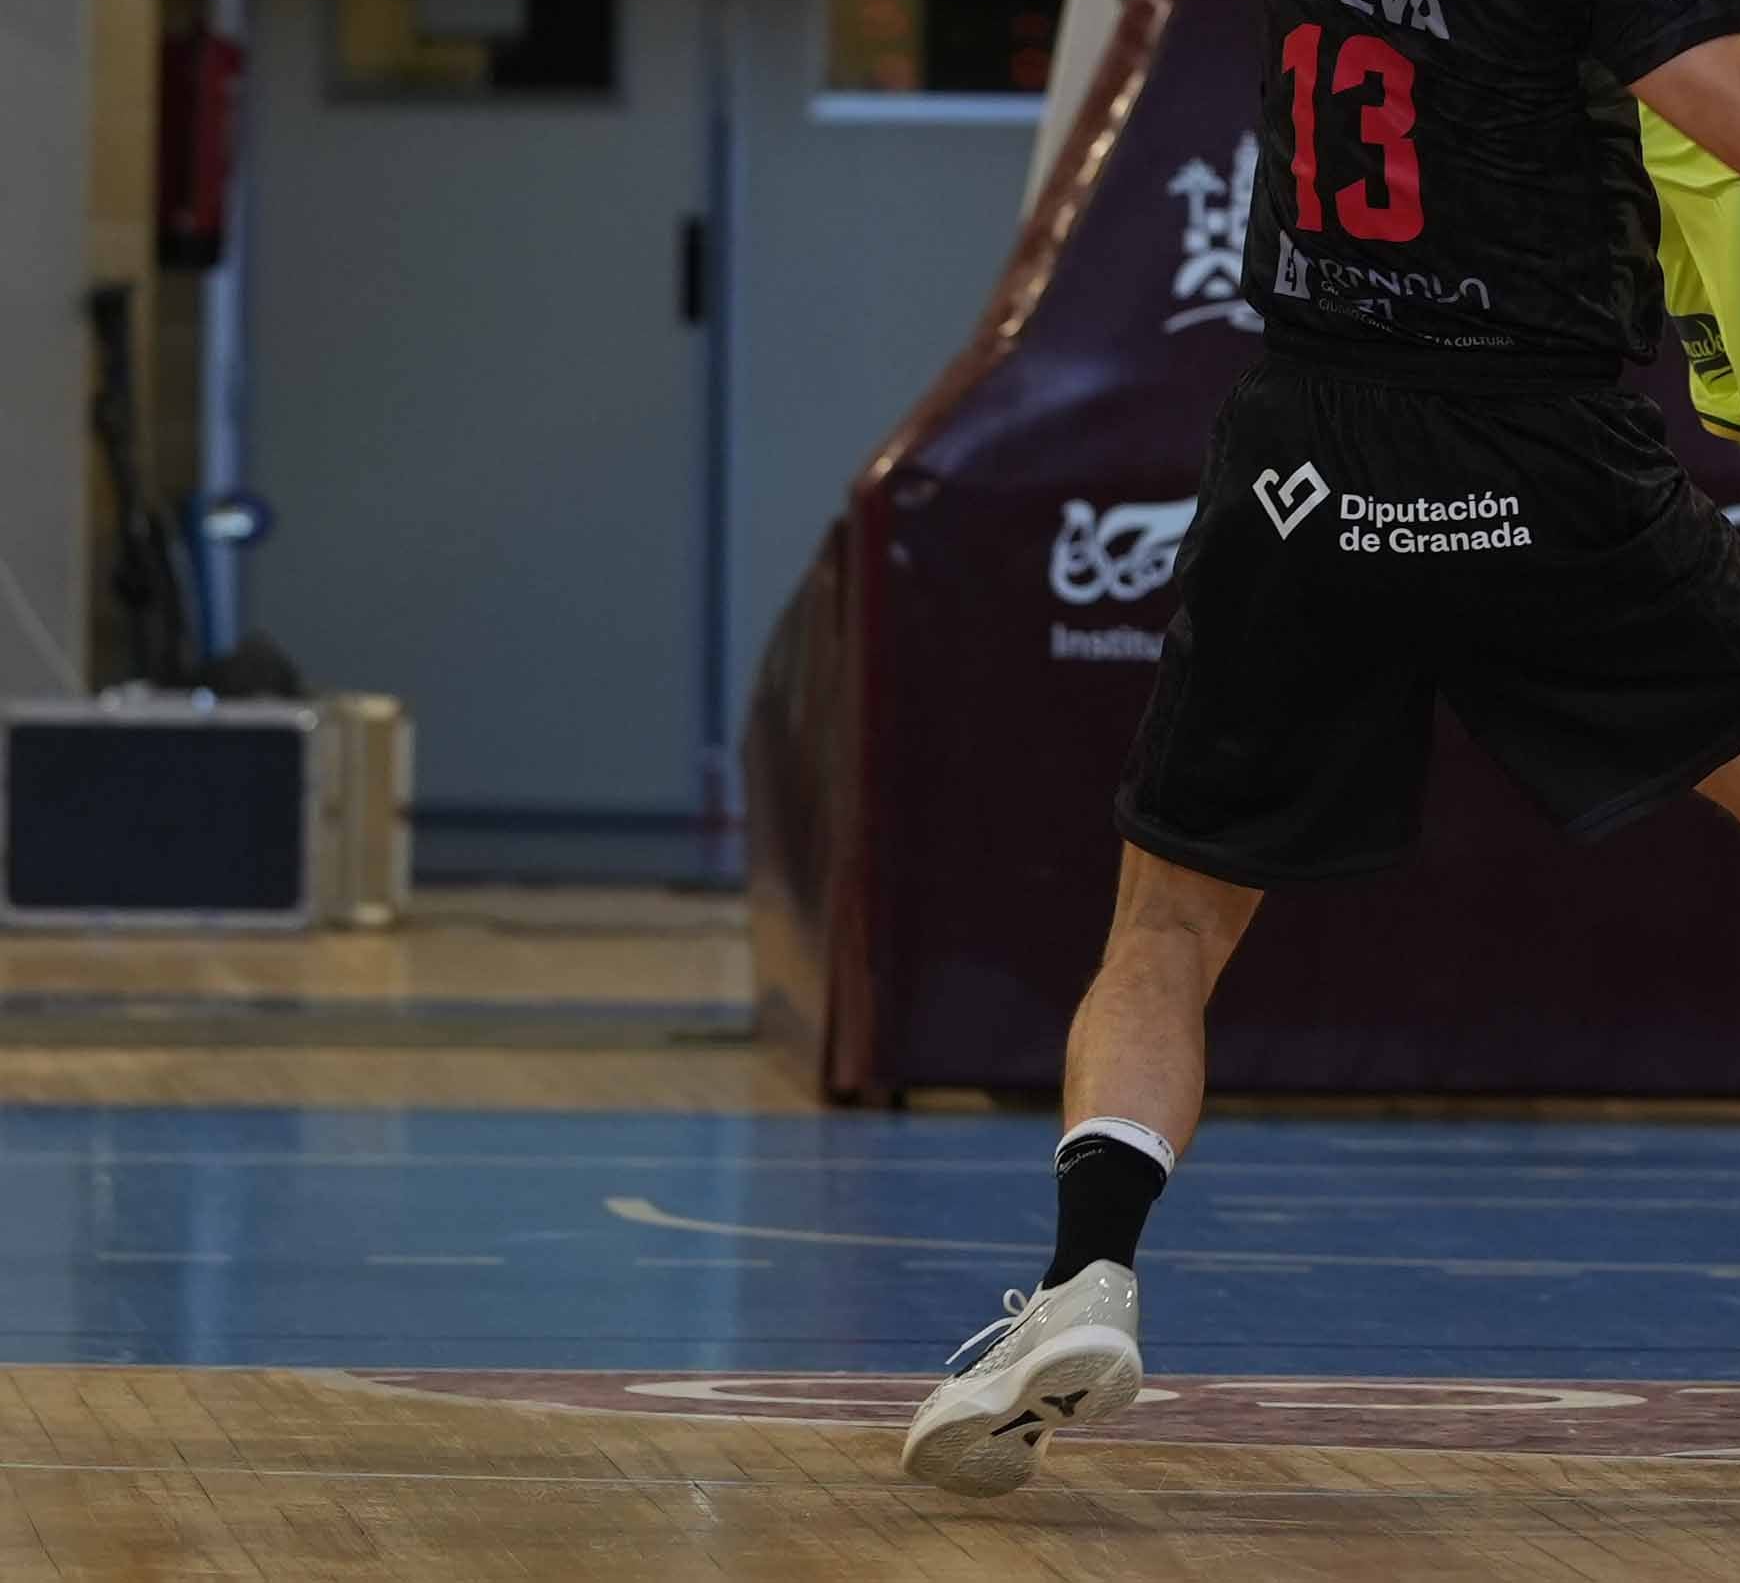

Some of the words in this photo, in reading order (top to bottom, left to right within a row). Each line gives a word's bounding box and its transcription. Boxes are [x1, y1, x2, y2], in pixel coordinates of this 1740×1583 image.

[1280, 23, 1425, 243] 13
[1339, 491, 1519, 528] Diputación
[1339, 525, 1381, 553] de
[1388, 521, 1532, 554] Granada
